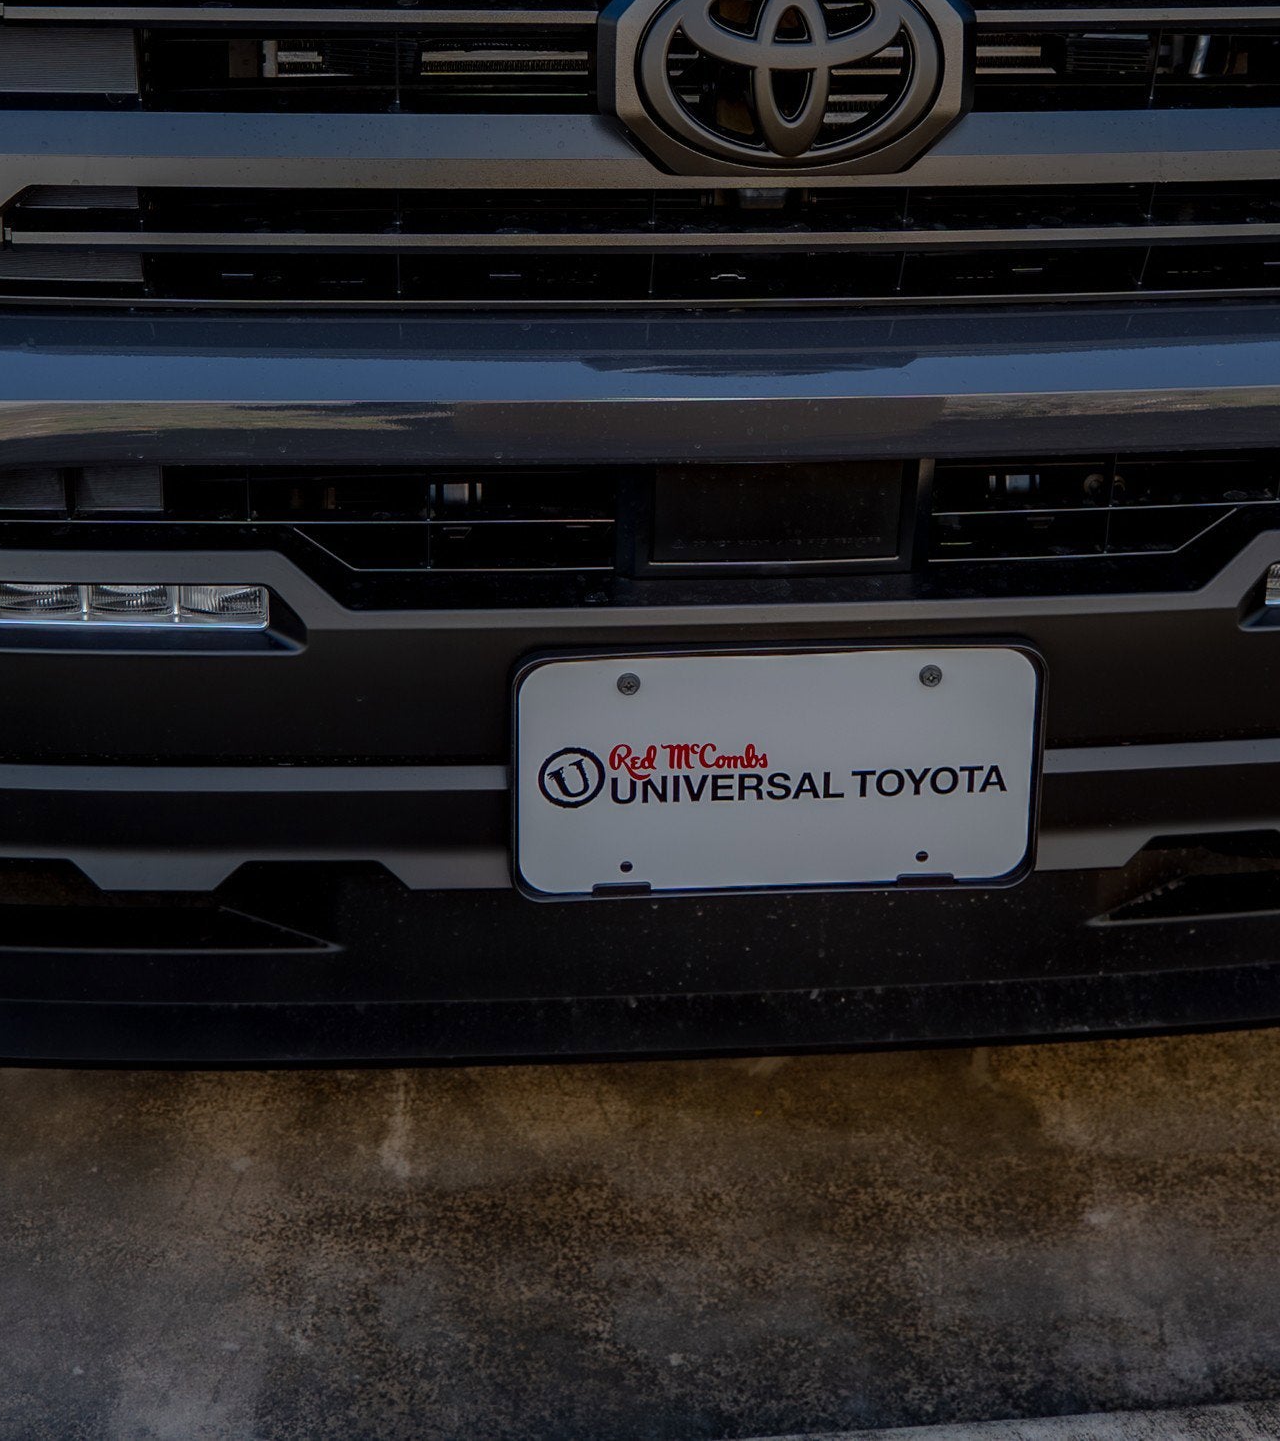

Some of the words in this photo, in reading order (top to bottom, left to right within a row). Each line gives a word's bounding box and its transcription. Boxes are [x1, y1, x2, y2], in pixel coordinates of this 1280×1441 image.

[608, 743, 658, 781] Red
[660, 742, 769, 770] McCombs
[610, 771, 845, 805] UNIVERSAL
[851, 764, 1008, 798] TOYOTA
